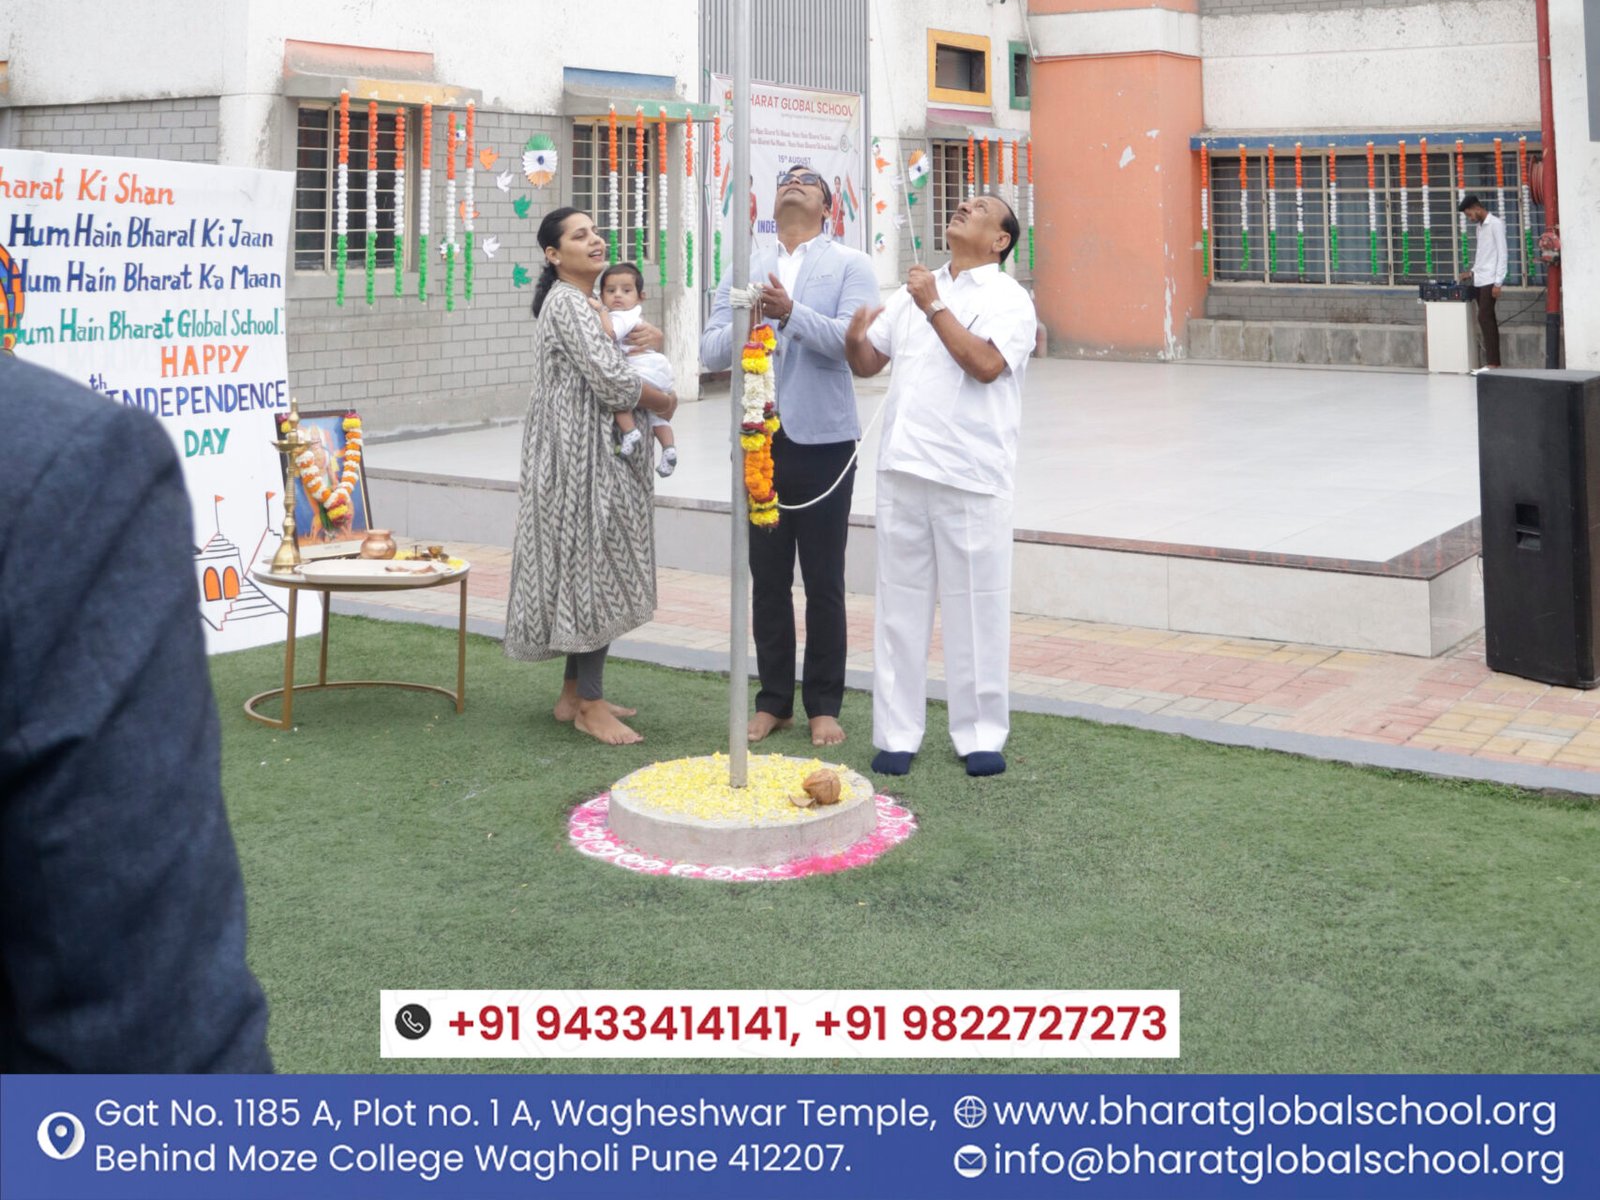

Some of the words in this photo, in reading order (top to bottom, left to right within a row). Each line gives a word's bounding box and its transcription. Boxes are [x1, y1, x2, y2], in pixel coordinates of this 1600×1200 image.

[751, 94, 779, 108] HARAT
[781, 97, 815, 113] GLOBAL
[788, 156, 811, 165] AUGUST
[0, 166, 64, 201] harat
[77, 168, 108, 202] Ki
[114, 172, 175, 205] Shan
[7, 213, 70, 247] Hum
[73, 213, 122, 247] Hain
[201, 217, 225, 247] Ki
[229, 218, 274, 248] Jaan
[7, 257, 62, 294] Hum
[66, 260, 116, 293] Hain
[123, 262, 193, 292] Bharat
[198, 263, 225, 291] Ka
[230, 264, 282, 290] Maan
[60, 307, 105, 342] Hain
[108, 309, 174, 341] Bharat
[177, 308, 228, 338] Global
[160, 344, 250, 378] HAPPY
[184, 427, 231, 458] DAY
